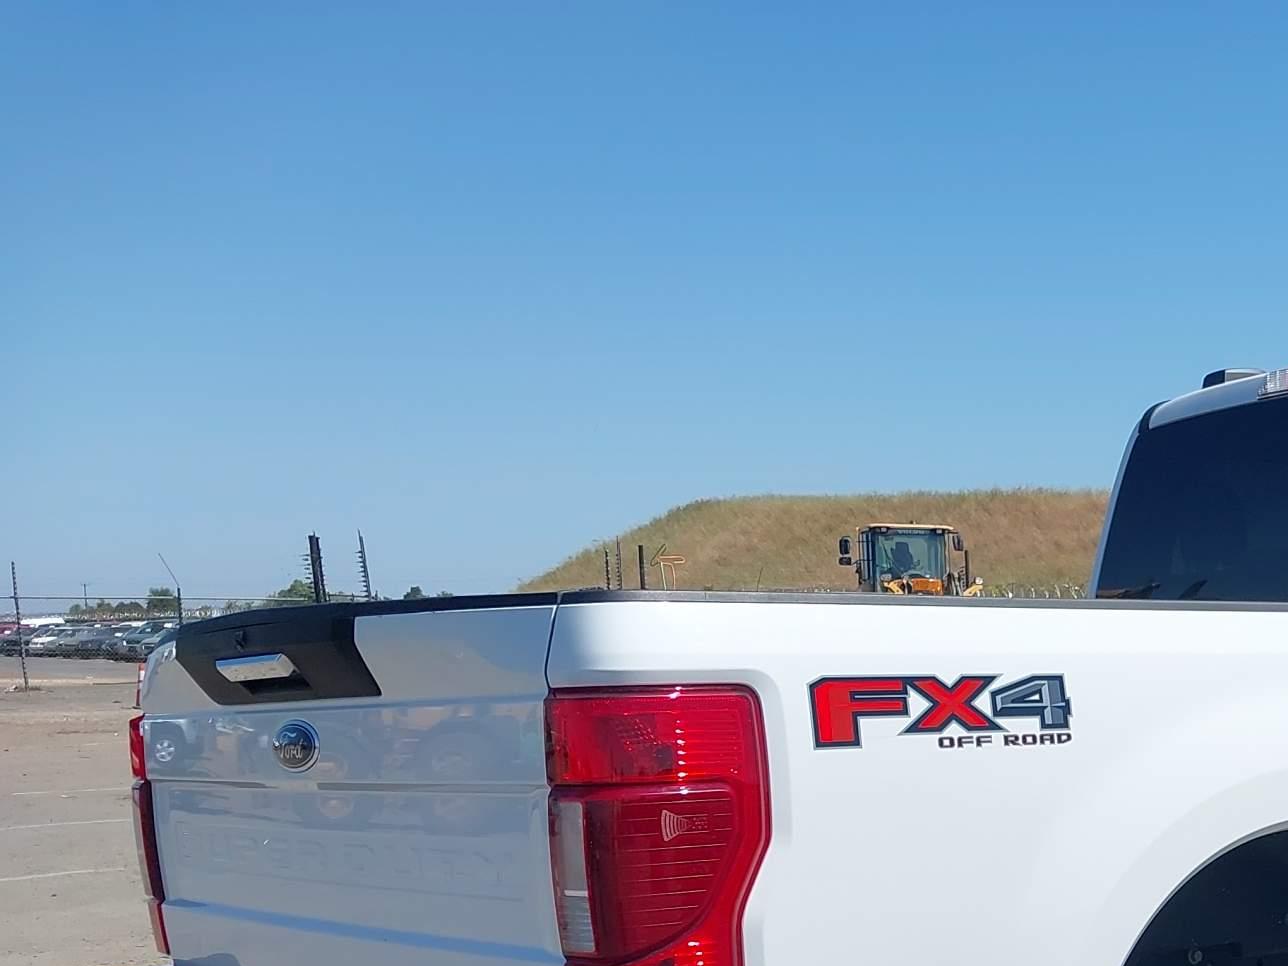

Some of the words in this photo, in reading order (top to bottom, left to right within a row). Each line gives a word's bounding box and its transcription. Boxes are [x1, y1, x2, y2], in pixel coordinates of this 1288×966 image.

[806, 673, 1073, 750] FX4
[937, 734, 993, 749] OFF
[1003, 732, 1073, 747] ROAD
